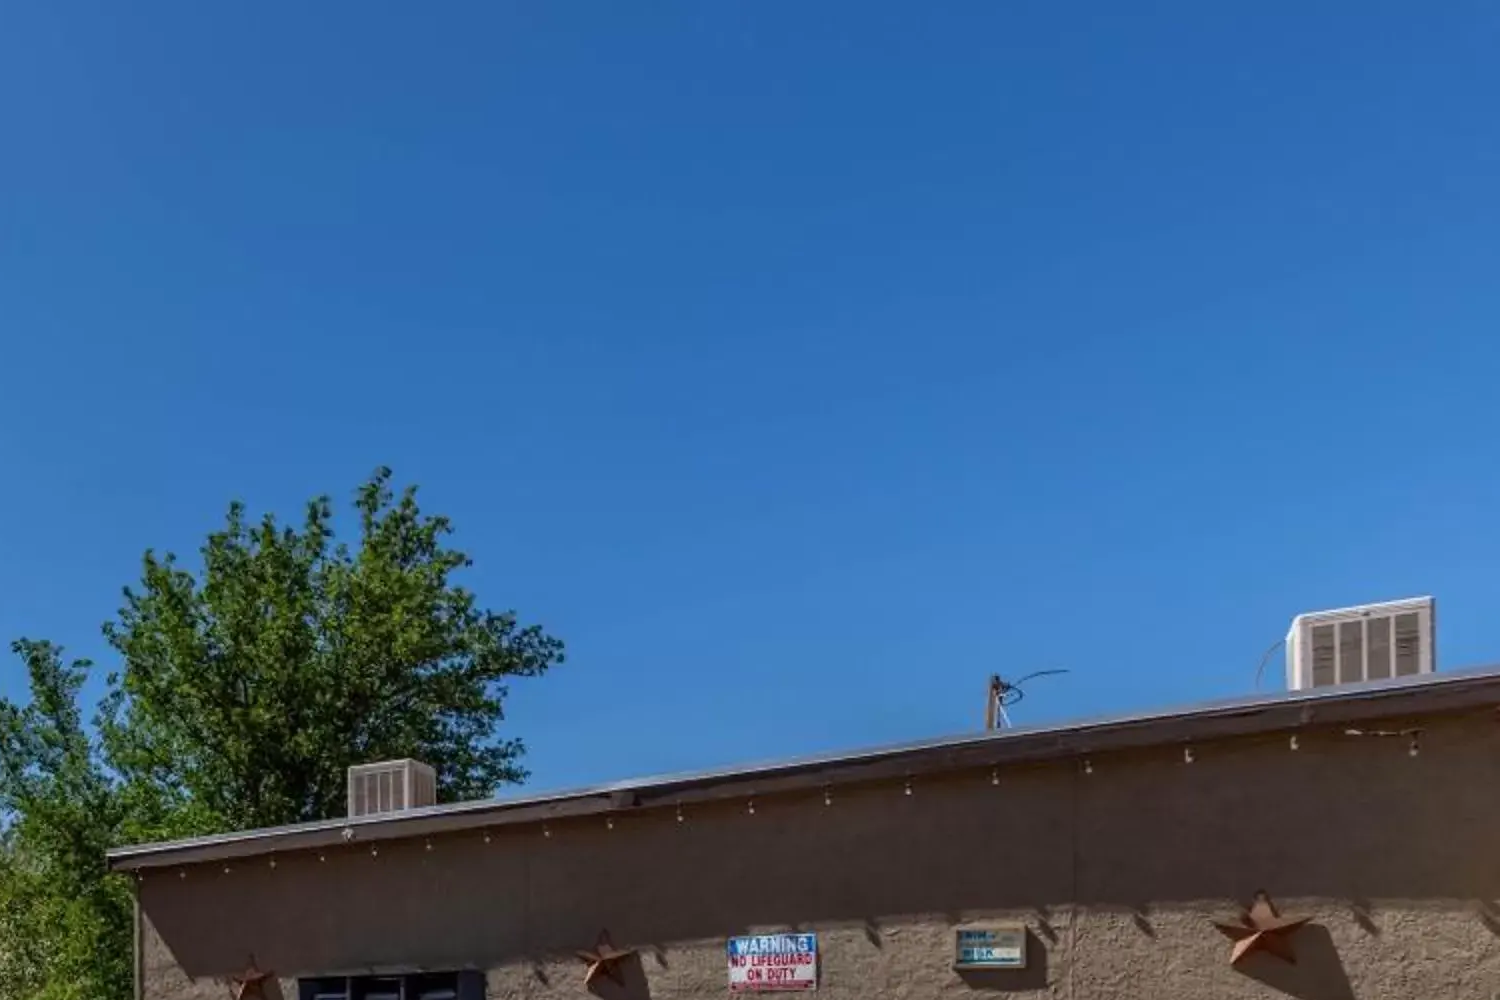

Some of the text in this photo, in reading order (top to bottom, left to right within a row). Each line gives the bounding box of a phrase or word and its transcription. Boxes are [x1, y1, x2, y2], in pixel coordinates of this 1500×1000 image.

[736, 935, 808, 954] WARNING
[731, 953, 812, 967] NO LIFEGUARD
[747, 967, 797, 980] ON DUTY
